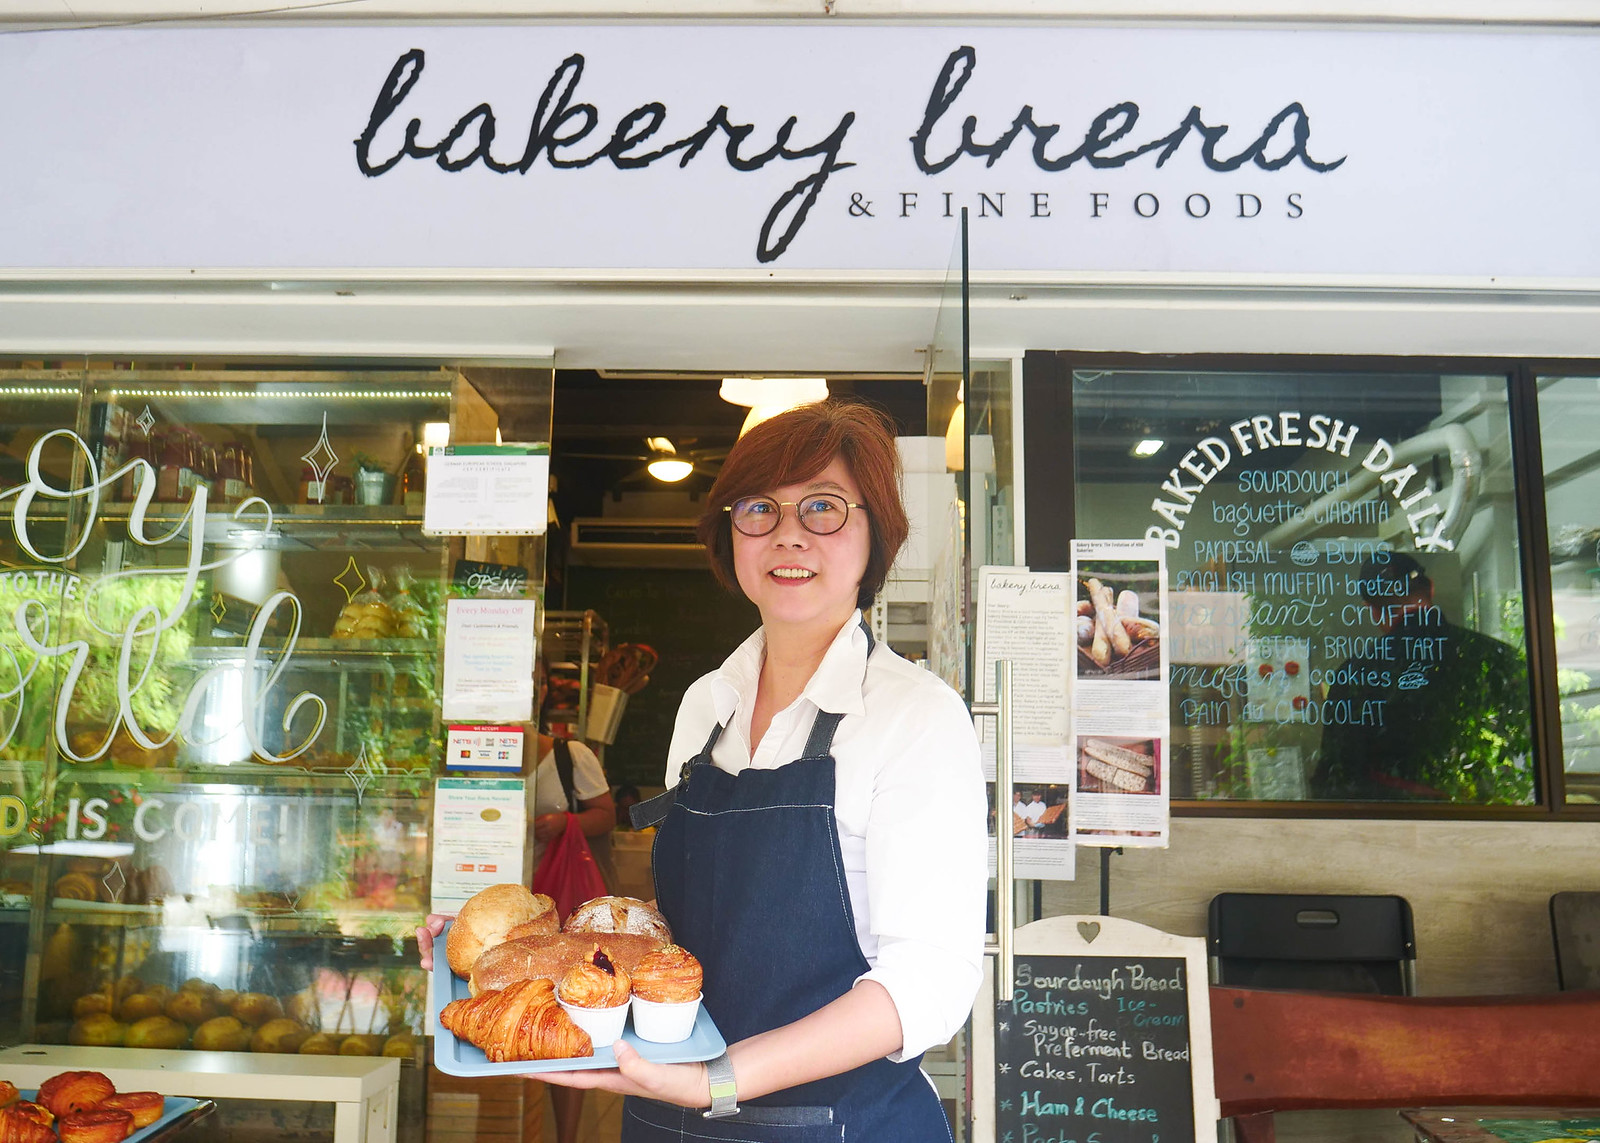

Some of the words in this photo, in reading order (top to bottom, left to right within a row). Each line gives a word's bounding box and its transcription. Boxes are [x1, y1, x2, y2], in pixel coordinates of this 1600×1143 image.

[354, 47, 858, 264] bakery
[909, 45, 1348, 176] brera
[848, 192, 875, 218] &
[899, 192, 1052, 218] FINE
[1090, 192, 1305, 219] FOODS
[1145, 436, 1232, 550] BAKED
[1230, 411, 1359, 458] FRESH
[1361, 438, 1455, 553] DAILY
[1237, 469, 1351, 494] SOURDOUGH
[1212, 500, 1305, 537] baguette
[34, 571, 80, 600] THE
[467, 573, 518, 593] OPEN
[991, 579, 1027, 596] bakery
[1344, 573, 1410, 597] bretzel
[456, 605, 477, 616] Every
[480, 605, 510, 615] Monday
[512, 606, 524, 615] Off
[1324, 635, 1396, 661] BRIOCHE
[1400, 636, 1448, 661] TART
[1310, 663, 1391, 688] cookies
[1274, 699, 1387, 727] CHOCOLAT
[66, 797, 109, 841] IS
[1015, 963, 1125, 1000] Sourdough
[1126, 964, 1184, 992] Bread
[1011, 989, 1089, 1016] Pastries
[1132, 1012, 1185, 1028] Cream
[1142, 1041, 1189, 1062] Bread
[1086, 1062, 1136, 1085] Tarts
[1020, 1090, 1069, 1117] Ham
[1073, 1096, 1085, 1116] &
[1091, 1097, 1159, 1123] Cheese
